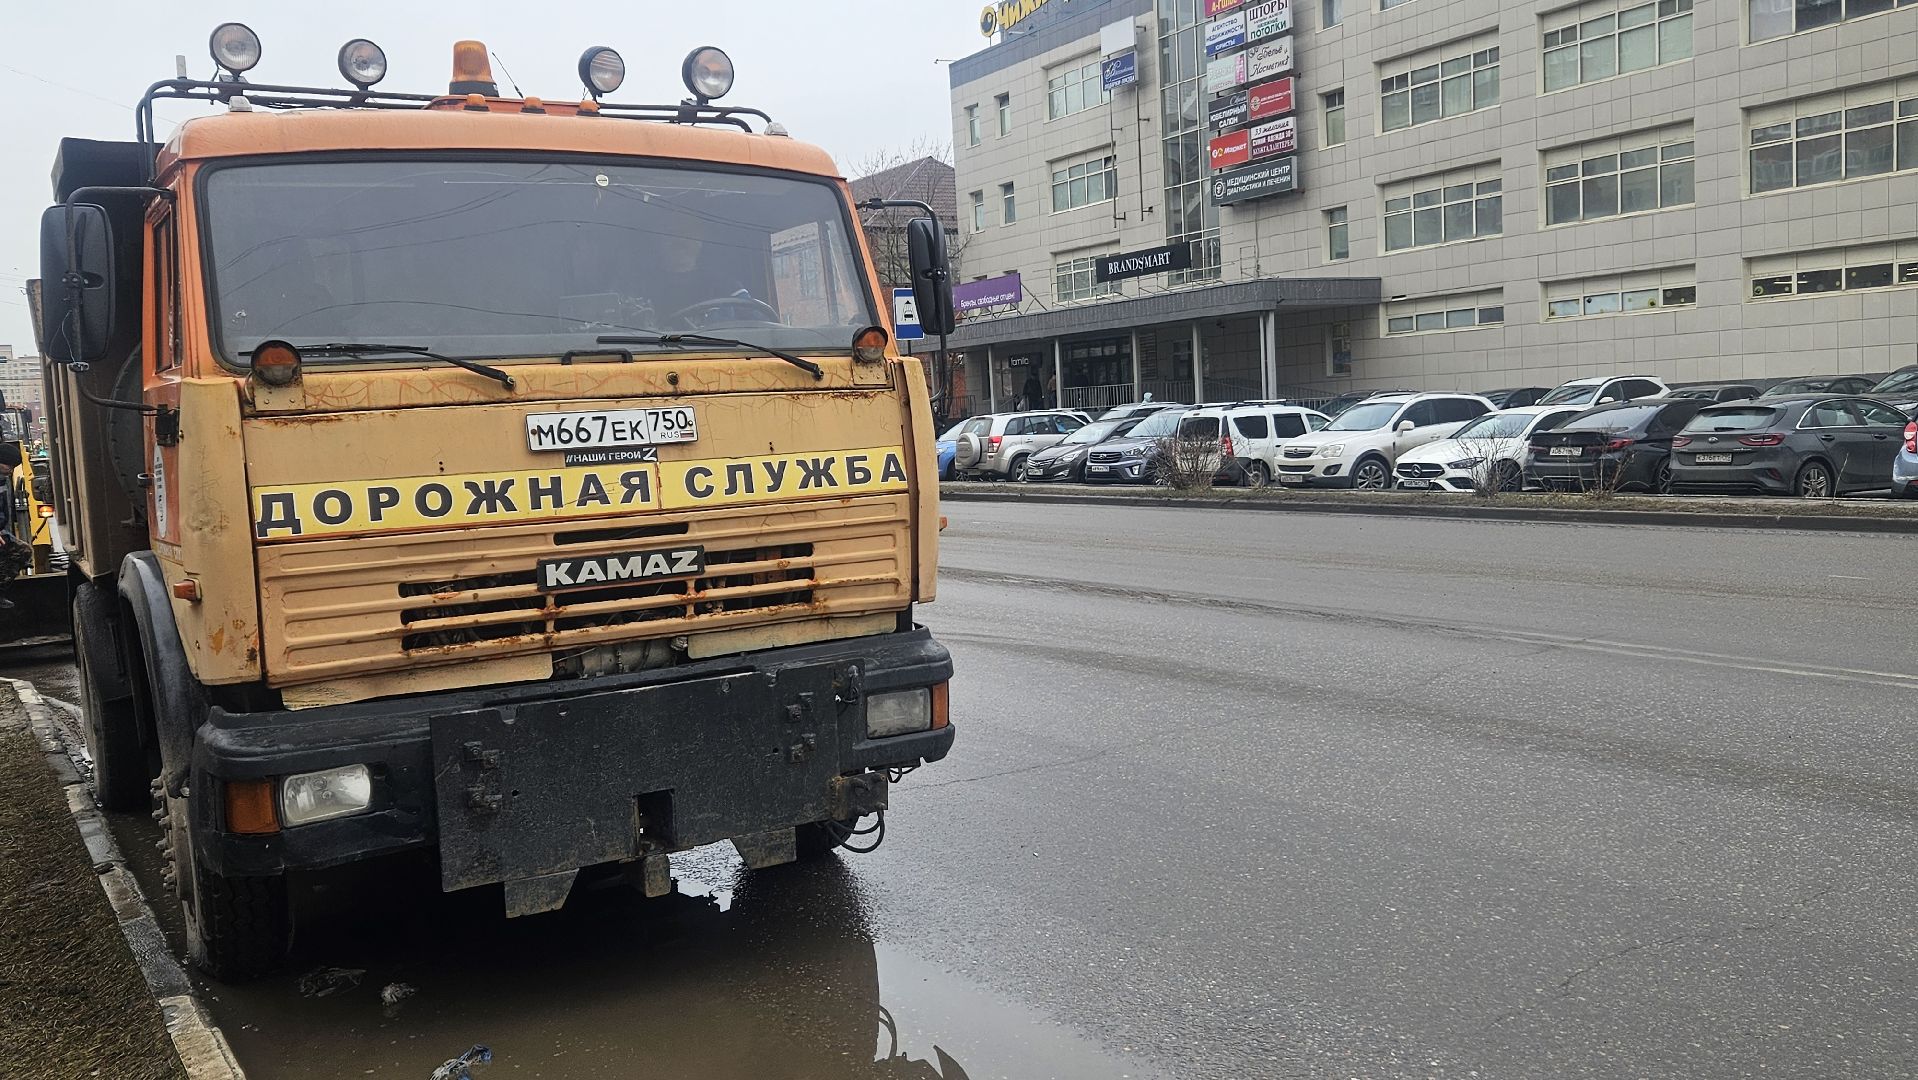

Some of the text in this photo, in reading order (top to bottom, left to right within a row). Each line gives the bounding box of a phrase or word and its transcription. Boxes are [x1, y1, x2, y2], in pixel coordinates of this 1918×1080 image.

[1249, 0, 1288, 21] ШТОРЫ
[1212, 18, 1238, 33] АГЕНТСТВО
[1250, 20, 1287, 39] ПОТОЛКИ
[1210, 104, 1247, 122] ЮВЕЛИРНЫЙ
[1218, 116, 1239, 128] САЛОН
[1226, 165, 1291, 187] МЕДИЦИНСКИЙ ЦЕНТР
[1226, 181, 1262, 196] ДИАГНОСТИКИ
[1267, 175, 1291, 186] ЛЕЧЕНИЯ
[1108, 251, 1171, 275] BRANDSMART
[536, 415, 645, 447] М667ЕК
[648, 410, 689, 432] 750
[660, 431, 680, 439] RUS
[608, 450, 641, 461] ГЕРОИ
[642, 446, 657, 462] Z
[256, 452, 907, 538] ДОРОЖНАЯ СЛУЖБА
[545, 551, 699, 587] KAMAZ
